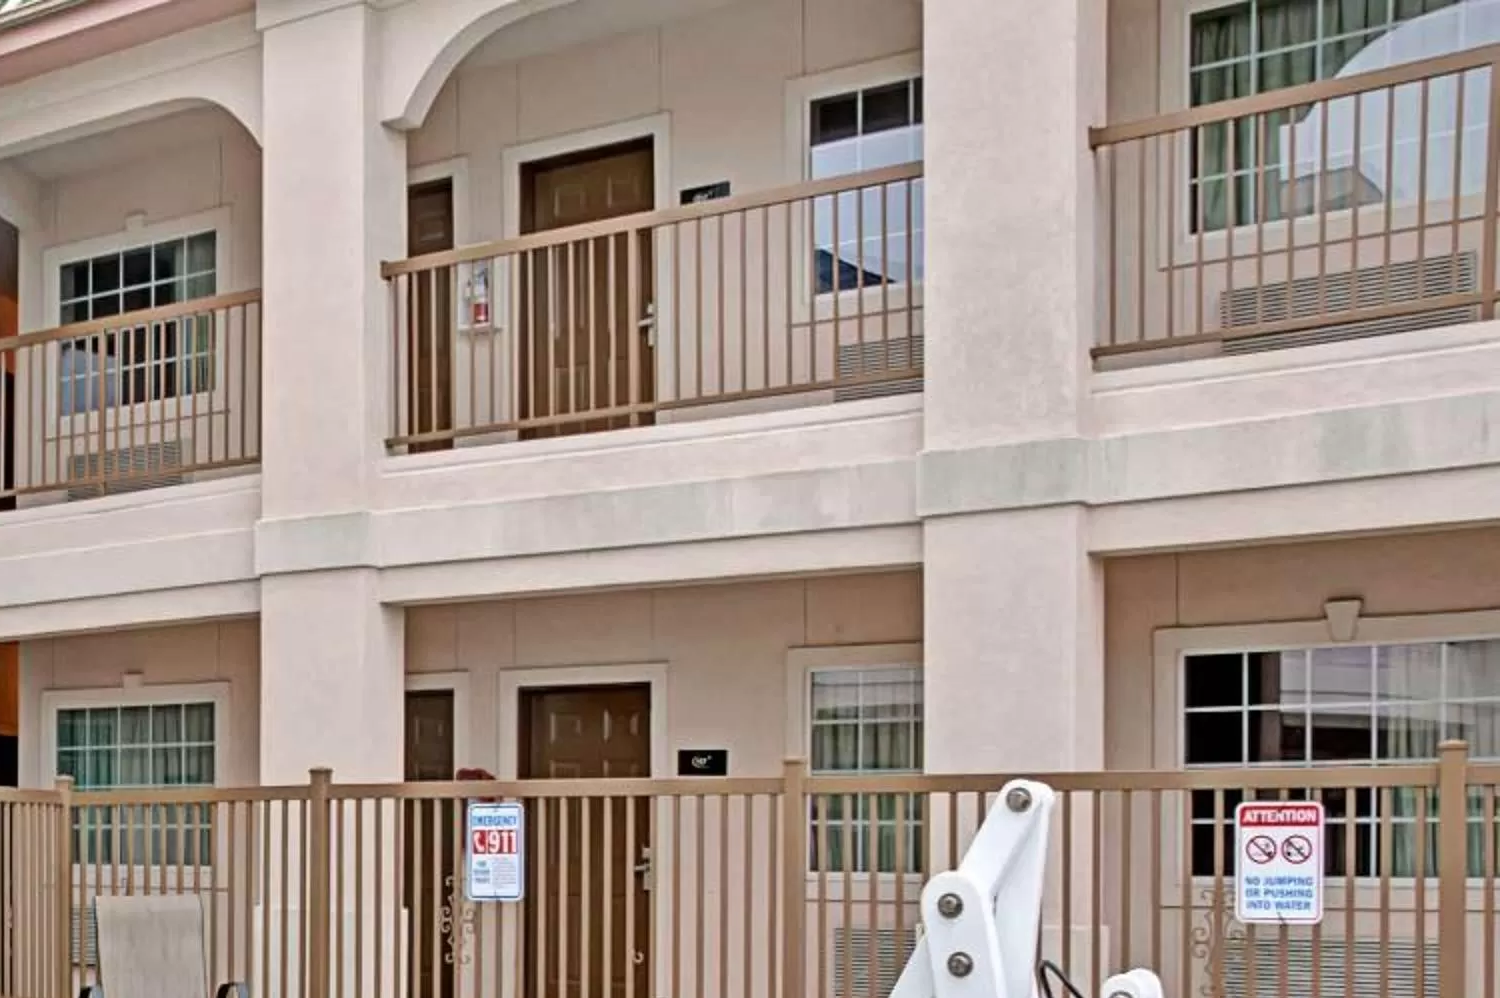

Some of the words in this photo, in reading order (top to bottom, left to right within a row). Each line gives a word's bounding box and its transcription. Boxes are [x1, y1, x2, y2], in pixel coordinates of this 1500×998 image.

[1242, 807, 1317, 823] ATTENTION
[472, 816, 517, 827] EMERGENCY
[488, 831, 517, 853] 911
[1245, 876, 1260, 886] NO
[1263, 876, 1313, 886] JUMPING
[1245, 888, 1260, 898] OR
[1263, 888, 1313, 898] PUSHING
[1246, 900, 1270, 910] INTO
[1276, 900, 1311, 910] WATER
